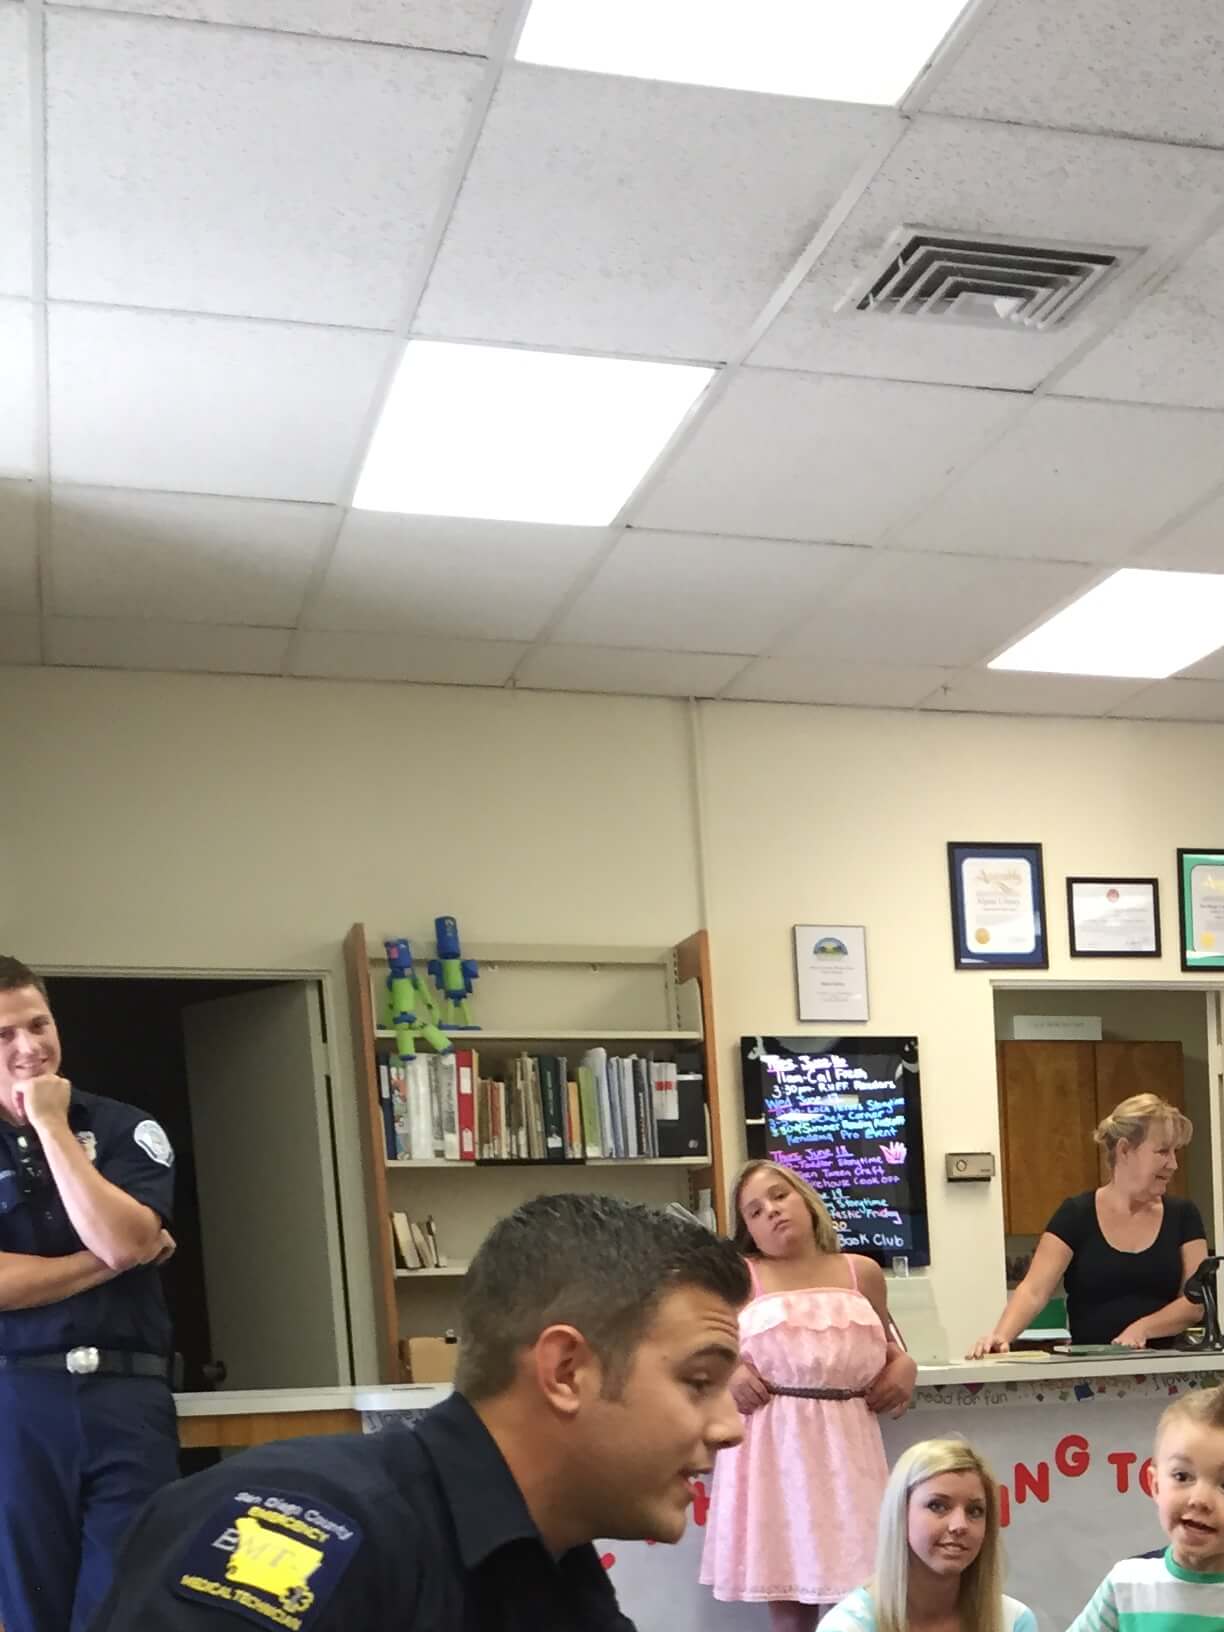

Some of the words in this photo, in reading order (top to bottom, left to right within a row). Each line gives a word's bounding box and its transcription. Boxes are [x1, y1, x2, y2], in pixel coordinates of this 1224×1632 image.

[985, 1391, 1008, 1405] fun
[302, 1508, 355, 1541] County
[230, 1588, 303, 1632] TECHNICIAN
